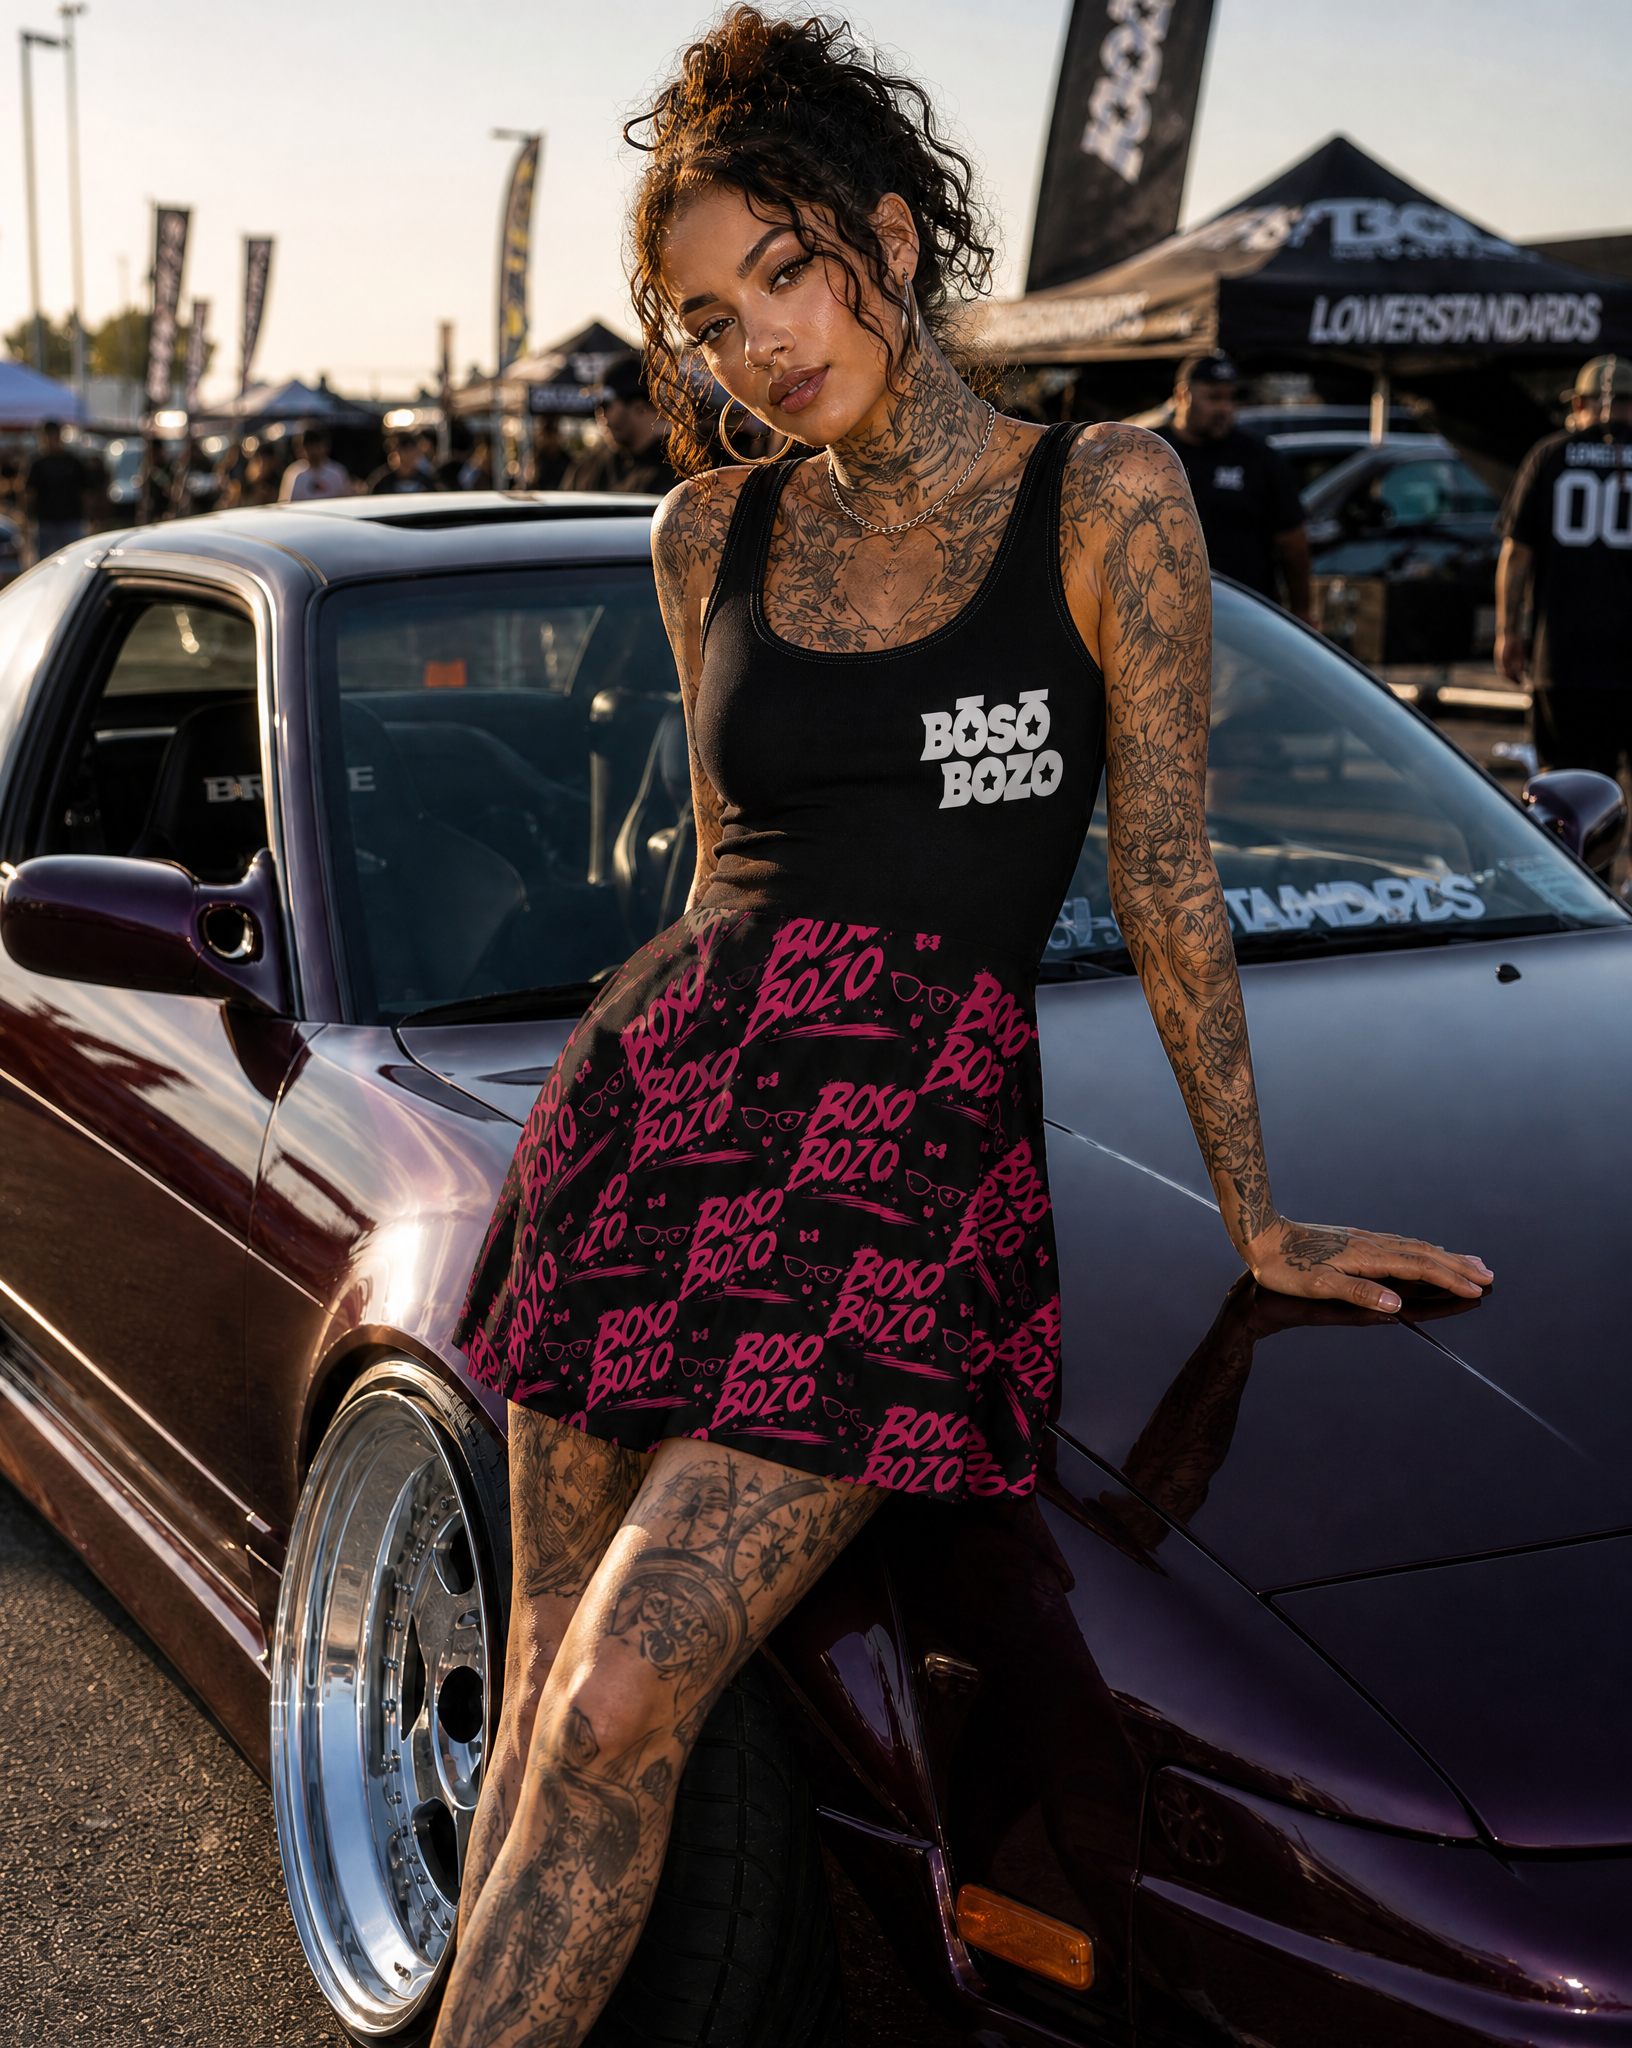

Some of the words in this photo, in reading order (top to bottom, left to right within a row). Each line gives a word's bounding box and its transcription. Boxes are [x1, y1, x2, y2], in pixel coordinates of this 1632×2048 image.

[1308, 293, 1604, 345] LOWERSTANDARDS
[203, 765, 376, 803] BRE
[938, 749, 1063, 809] BOZO
[739, 946, 884, 1048] BOZO
[946, 968, 1031, 1058] BOSO
[633, 1047, 740, 1130] BOSO
[799, 1079, 917, 1142] BOSO
[627, 1091, 733, 1173] BOZO
[784, 1137, 900, 1192] BOZO
[686, 1187, 784, 1253] BOSO
[678, 1230, 777, 1302] BOZO
[836, 1246, 945, 1299] BOSO
[590, 1300, 679, 1366] BOSO
[824, 1295, 936, 1344] BOZO
[586, 1341, 674, 1412] BOZO
[720, 1331, 824, 1396] BOSO
[708, 1374, 816, 1430] BOZO
[865, 1402, 968, 1458] BOSO
[856, 1454, 964, 1493] BOZO
